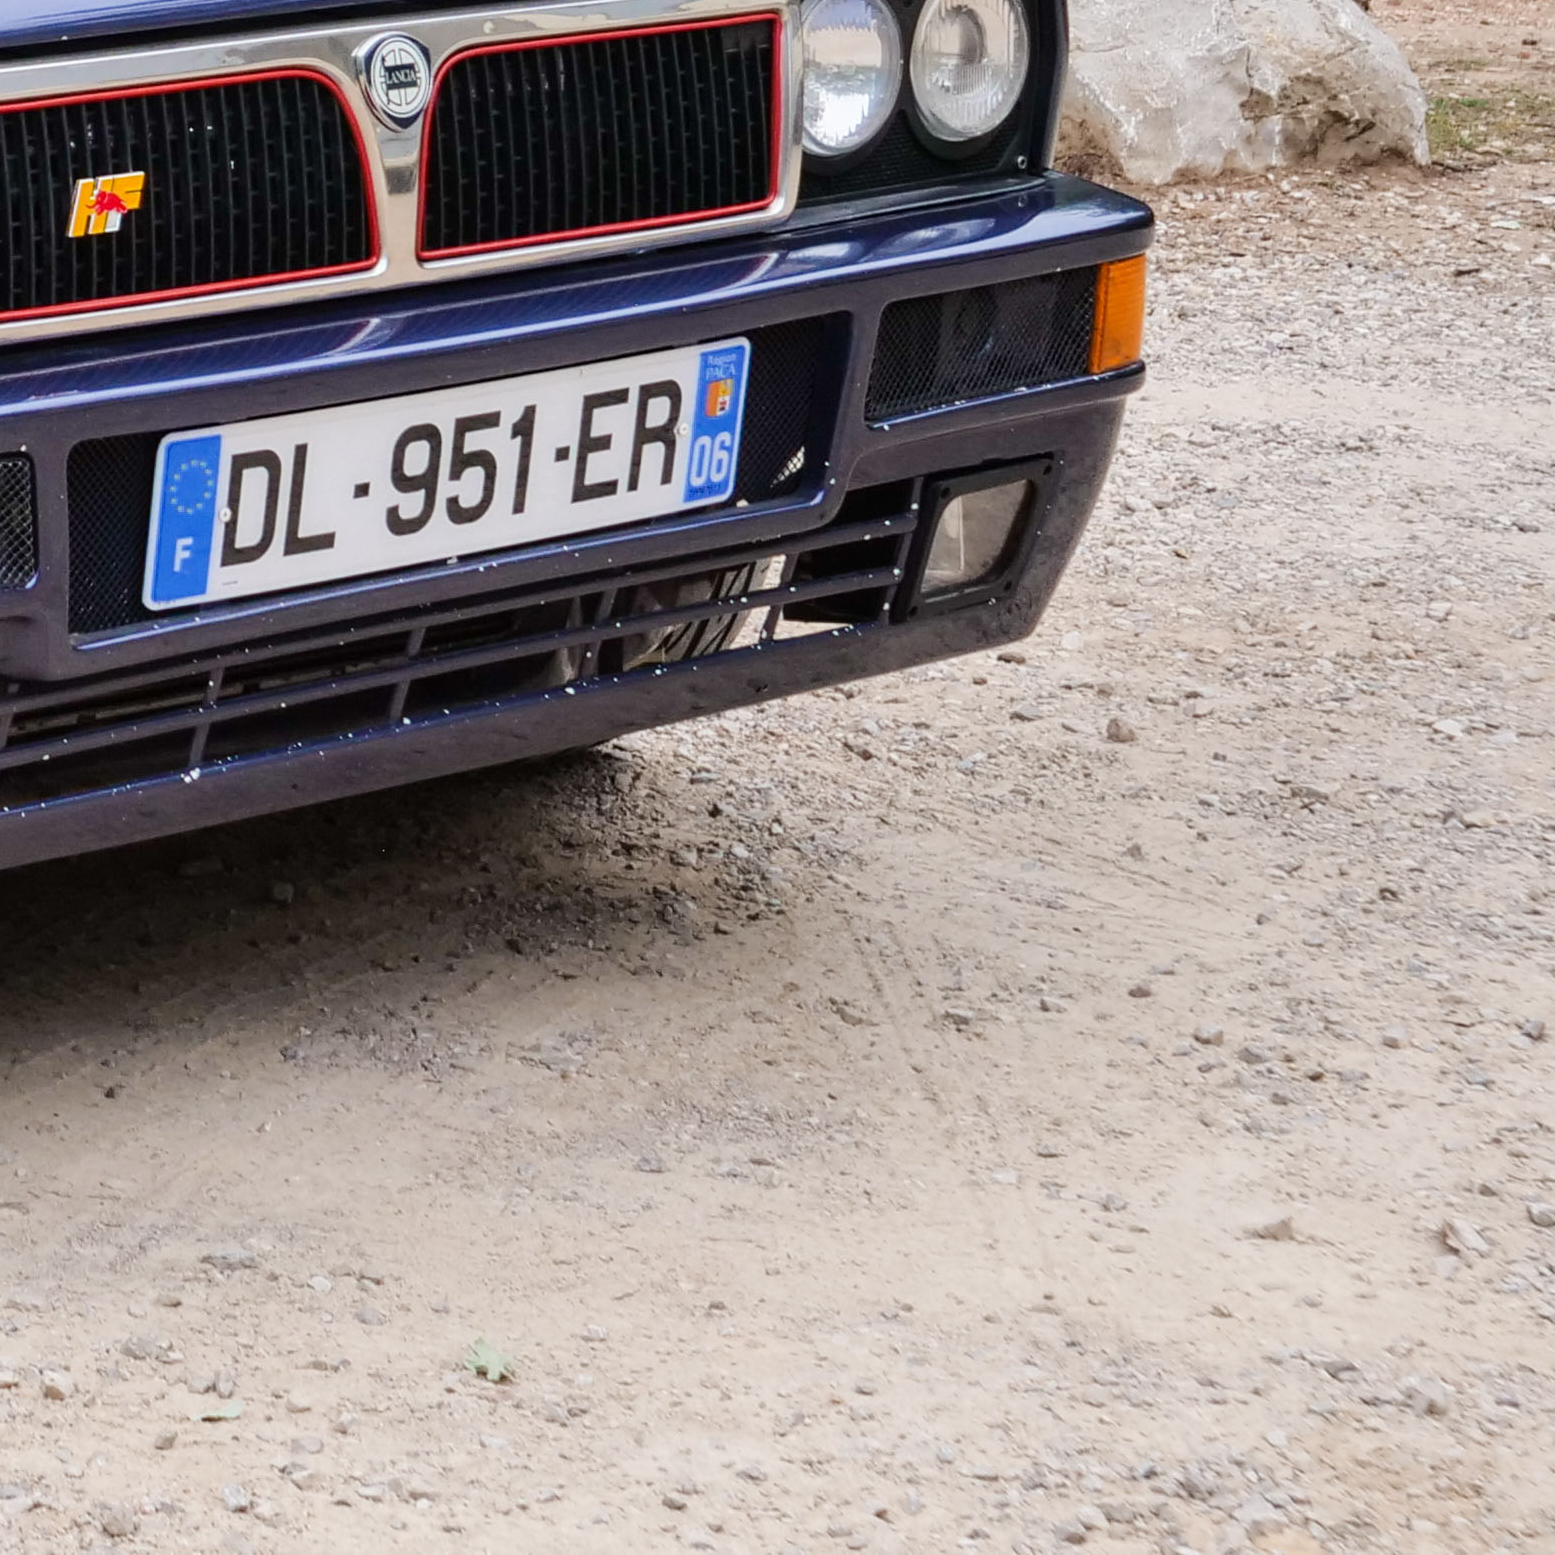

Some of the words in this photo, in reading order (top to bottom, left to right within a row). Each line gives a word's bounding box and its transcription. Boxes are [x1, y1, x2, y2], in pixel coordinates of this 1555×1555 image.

[384, 68, 417, 85] LANCIA
[66, 170, 145, 238] HF
[705, 363, 738, 381] PACA
[690, 431, 732, 486] 06
[173, 536, 194, 573] F
